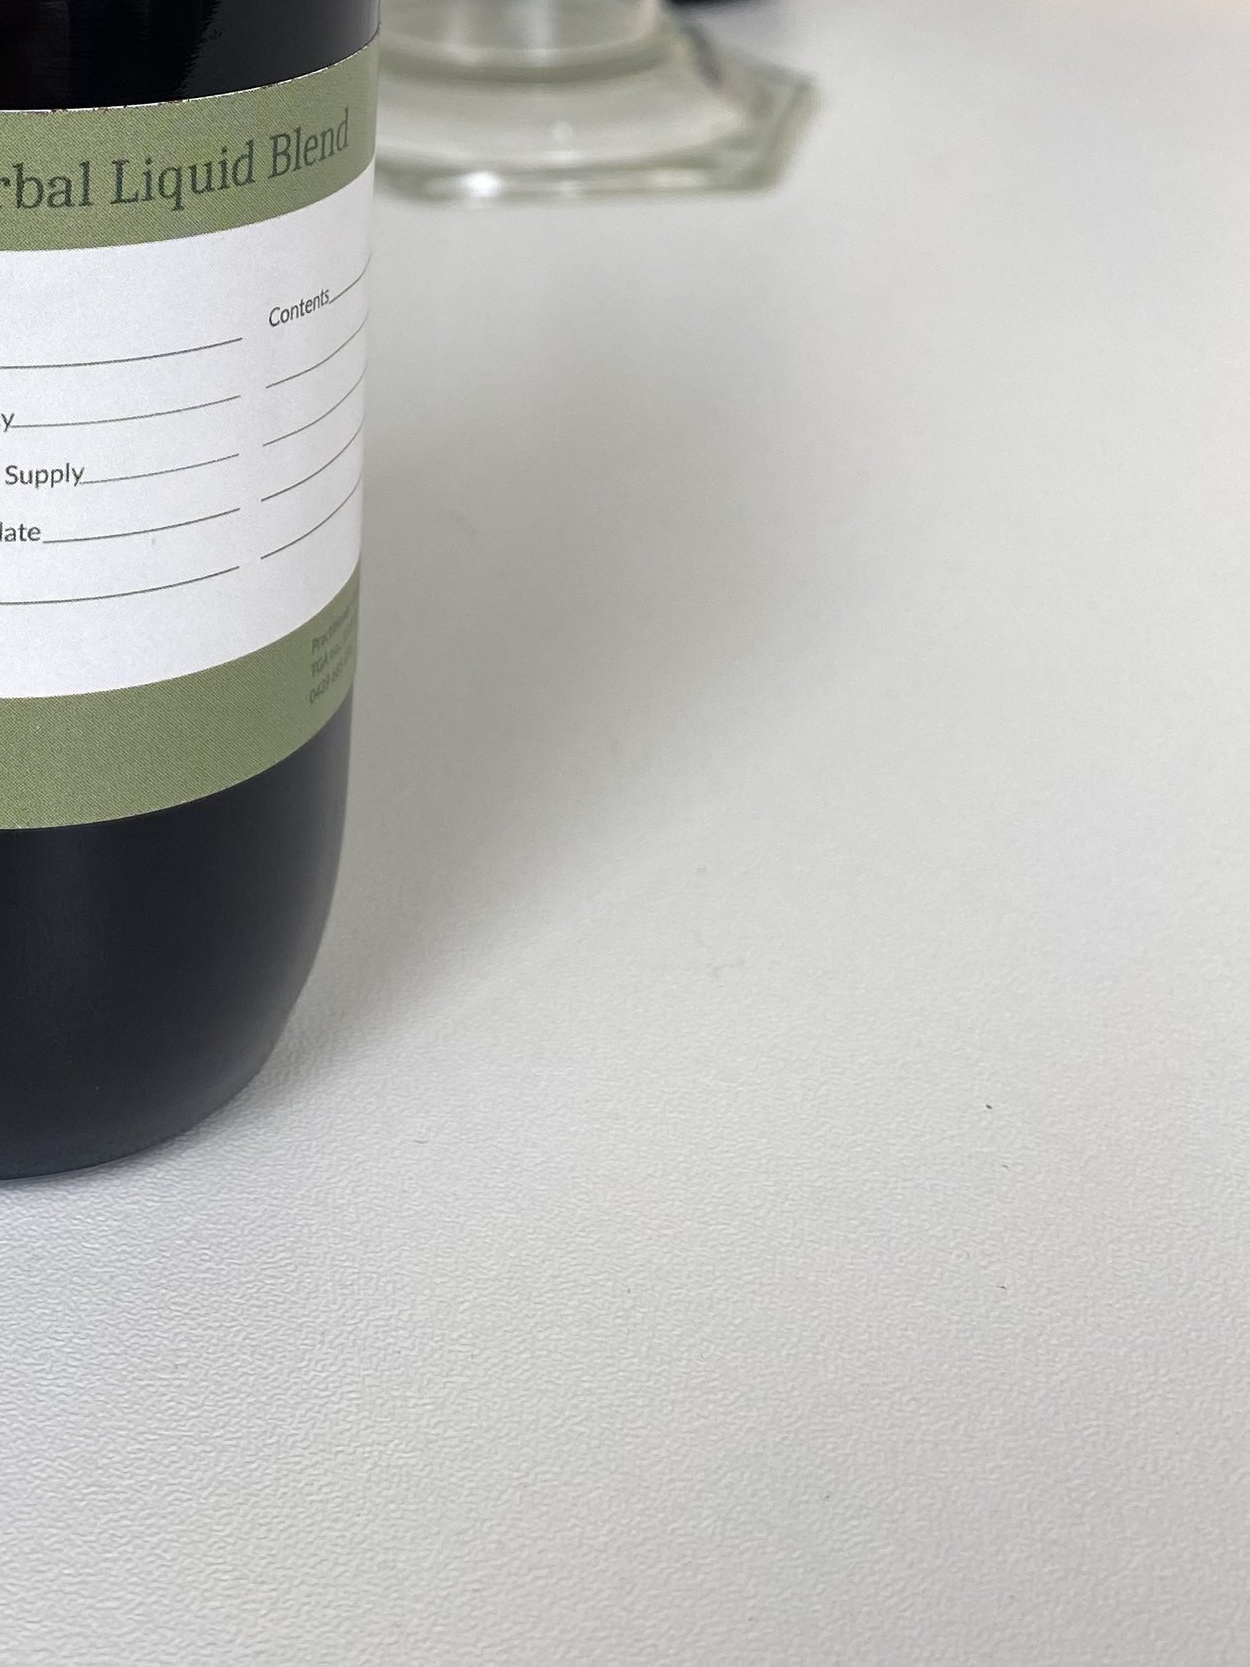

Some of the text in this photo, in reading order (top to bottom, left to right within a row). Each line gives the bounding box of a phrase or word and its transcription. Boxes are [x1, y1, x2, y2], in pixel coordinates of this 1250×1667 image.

[110, 140, 256, 212] Liquid
[268, 107, 352, 179] Blend
[268, 287, 331, 328] Contents
[5, 462, 85, 489] Supply
